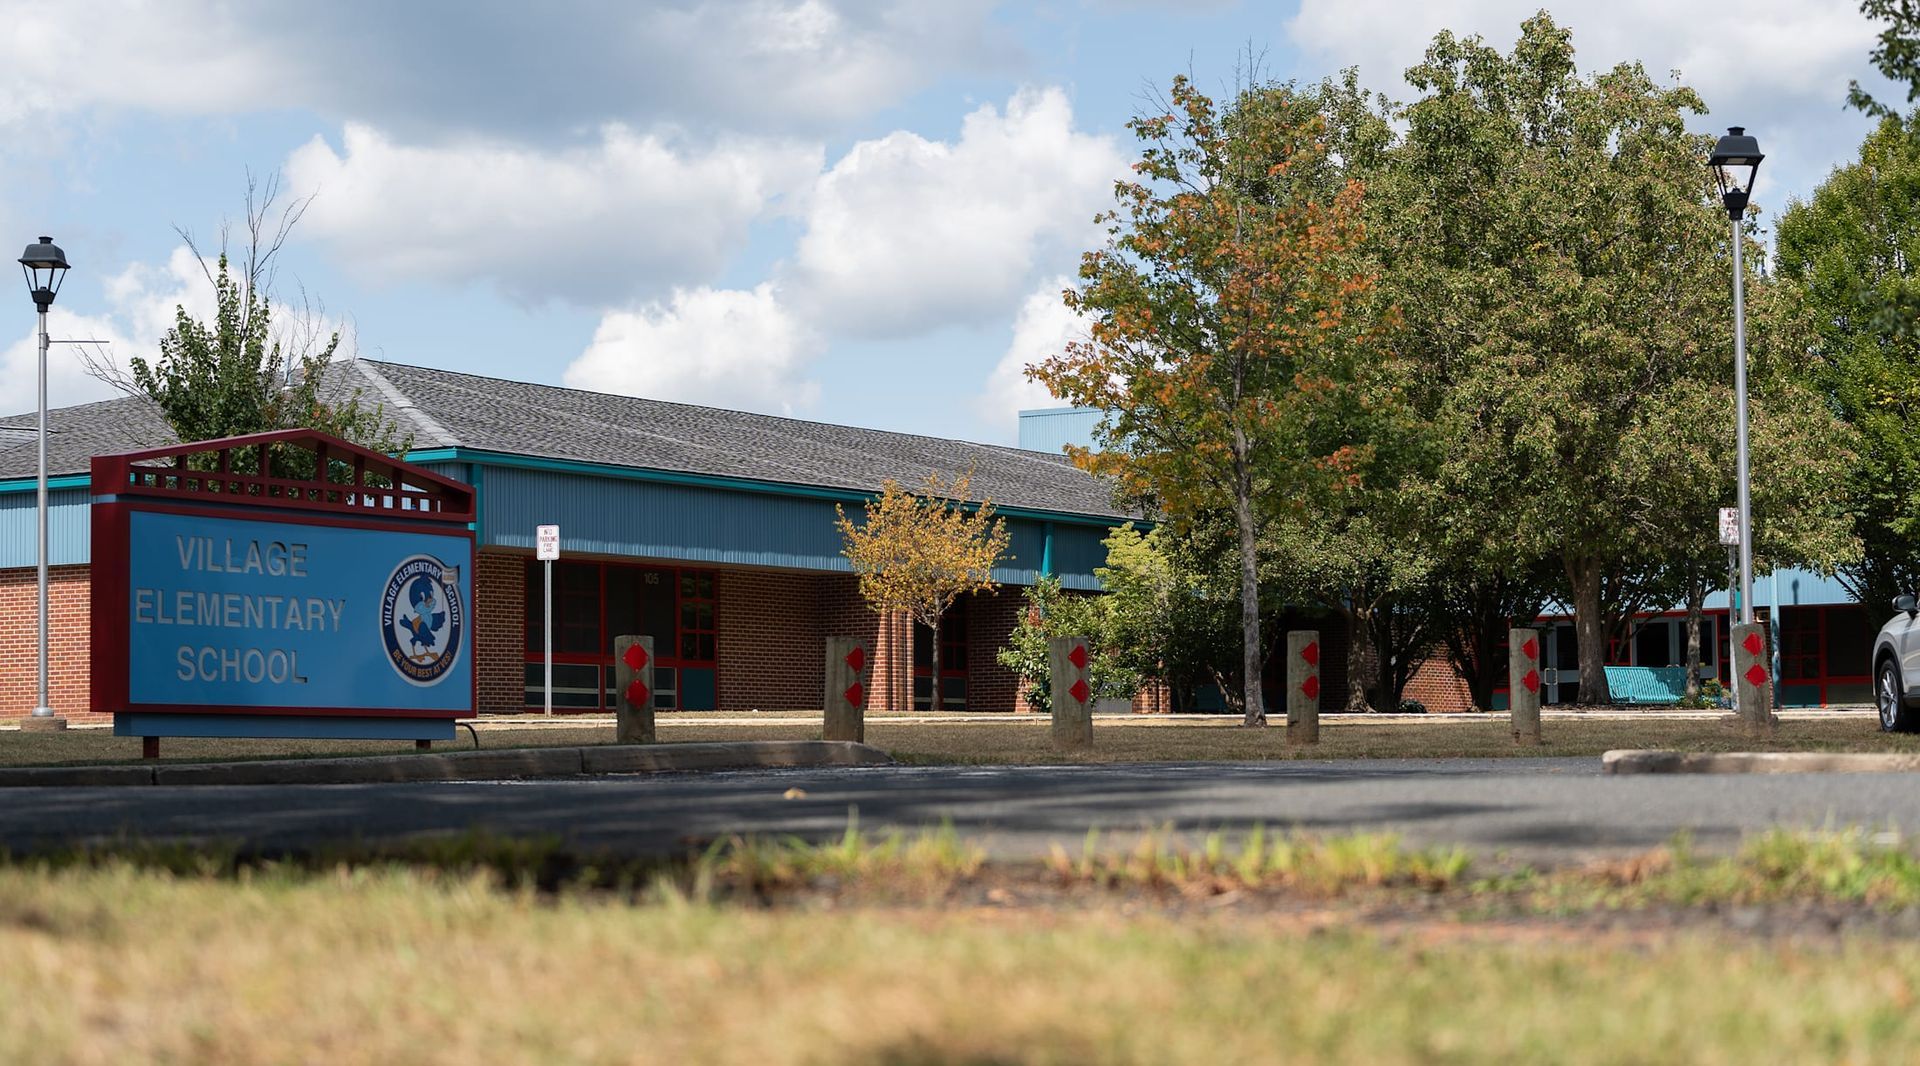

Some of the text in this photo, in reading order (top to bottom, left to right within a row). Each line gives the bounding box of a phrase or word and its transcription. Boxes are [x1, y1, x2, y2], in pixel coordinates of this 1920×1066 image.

[175, 535, 308, 577] VILLAGE
[384, 562, 459, 627] VILLAGE ELEMENTARY SCHOOL
[643, 573, 660, 585] 105
[135, 588, 346, 632] ELEMENTARY
[176, 645, 308, 683] SCHOOL
[393, 649, 403, 661] BE
[402, 659, 416, 676] YOUR
[417, 668, 433, 678] BEST
[433, 663, 441, 675] AT
